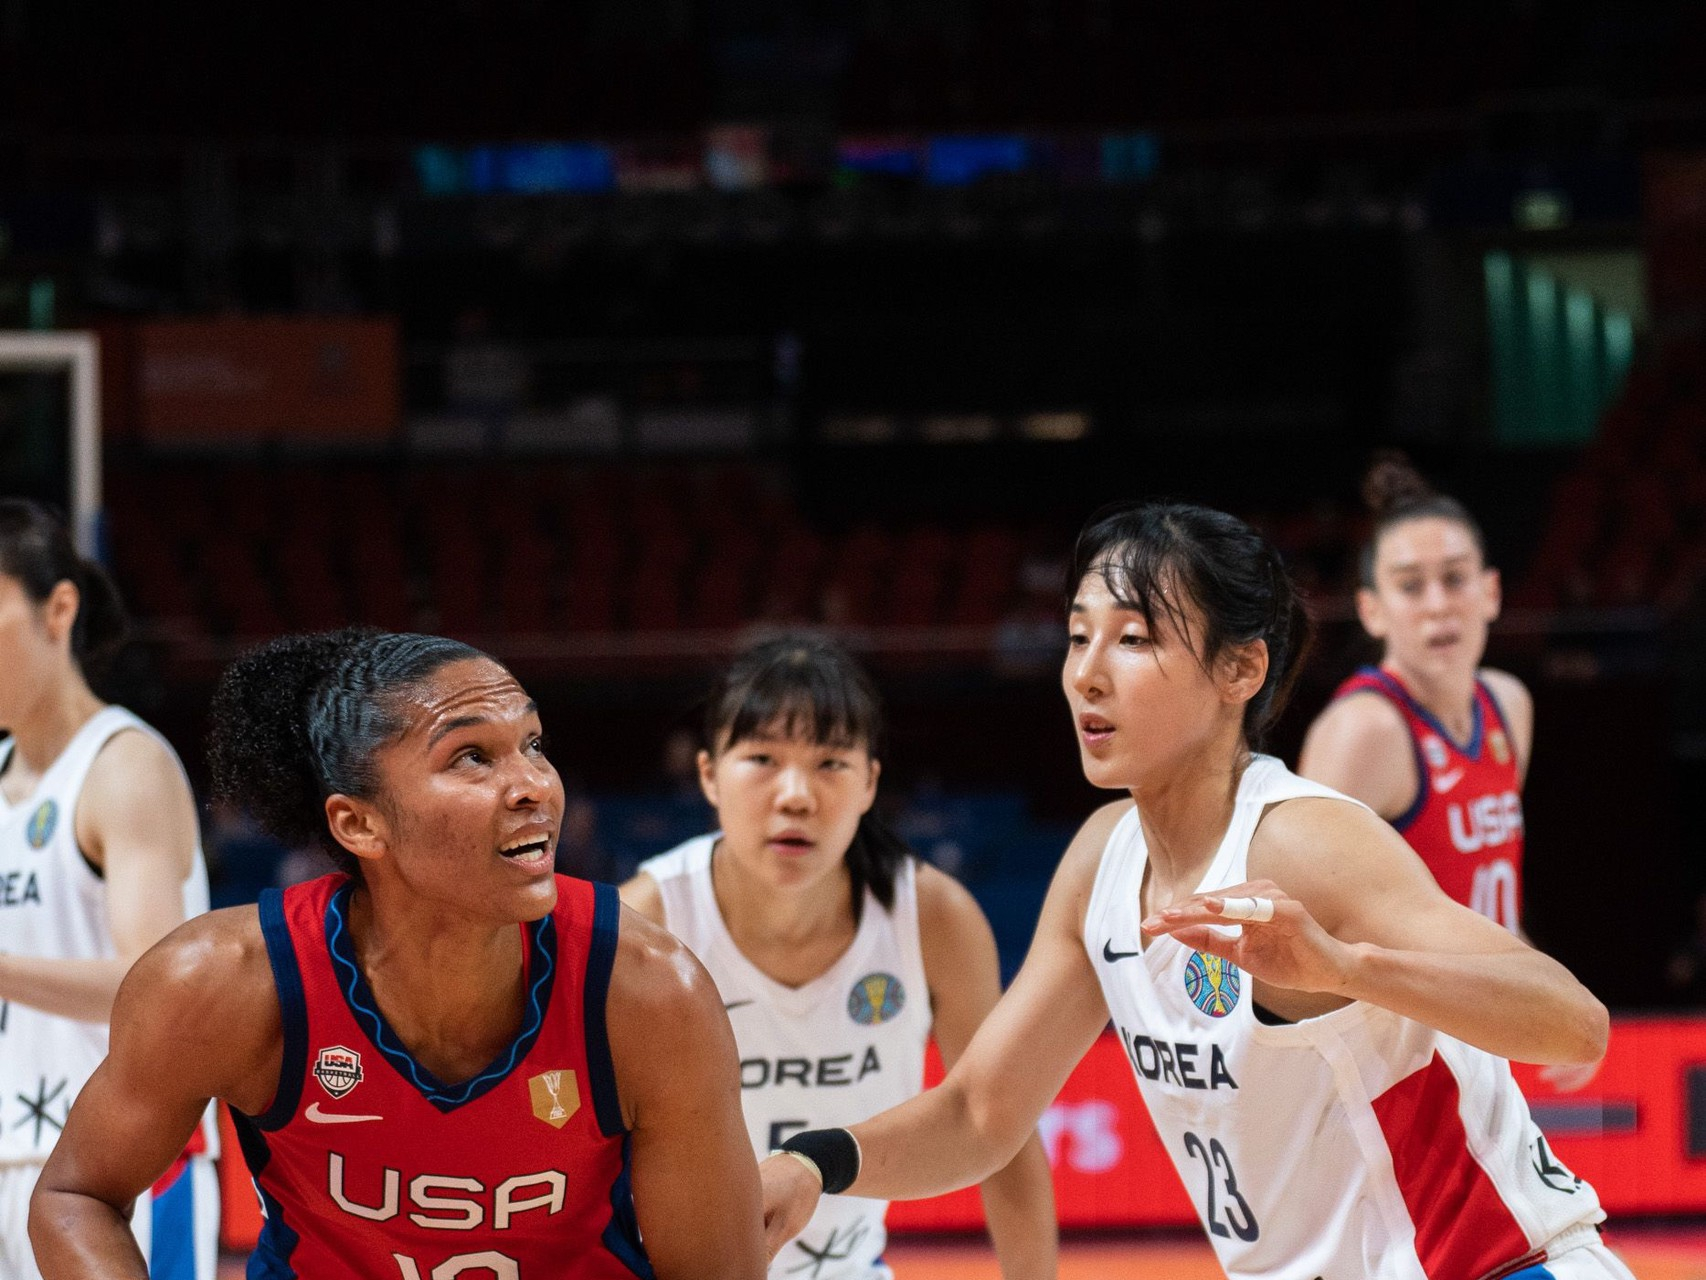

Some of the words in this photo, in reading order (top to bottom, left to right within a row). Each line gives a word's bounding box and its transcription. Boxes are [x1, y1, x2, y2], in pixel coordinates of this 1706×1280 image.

[740, 1046, 881, 1089] OREA
[328, 1150, 567, 1230] USA
[1183, 1131, 1260, 1243] 23
